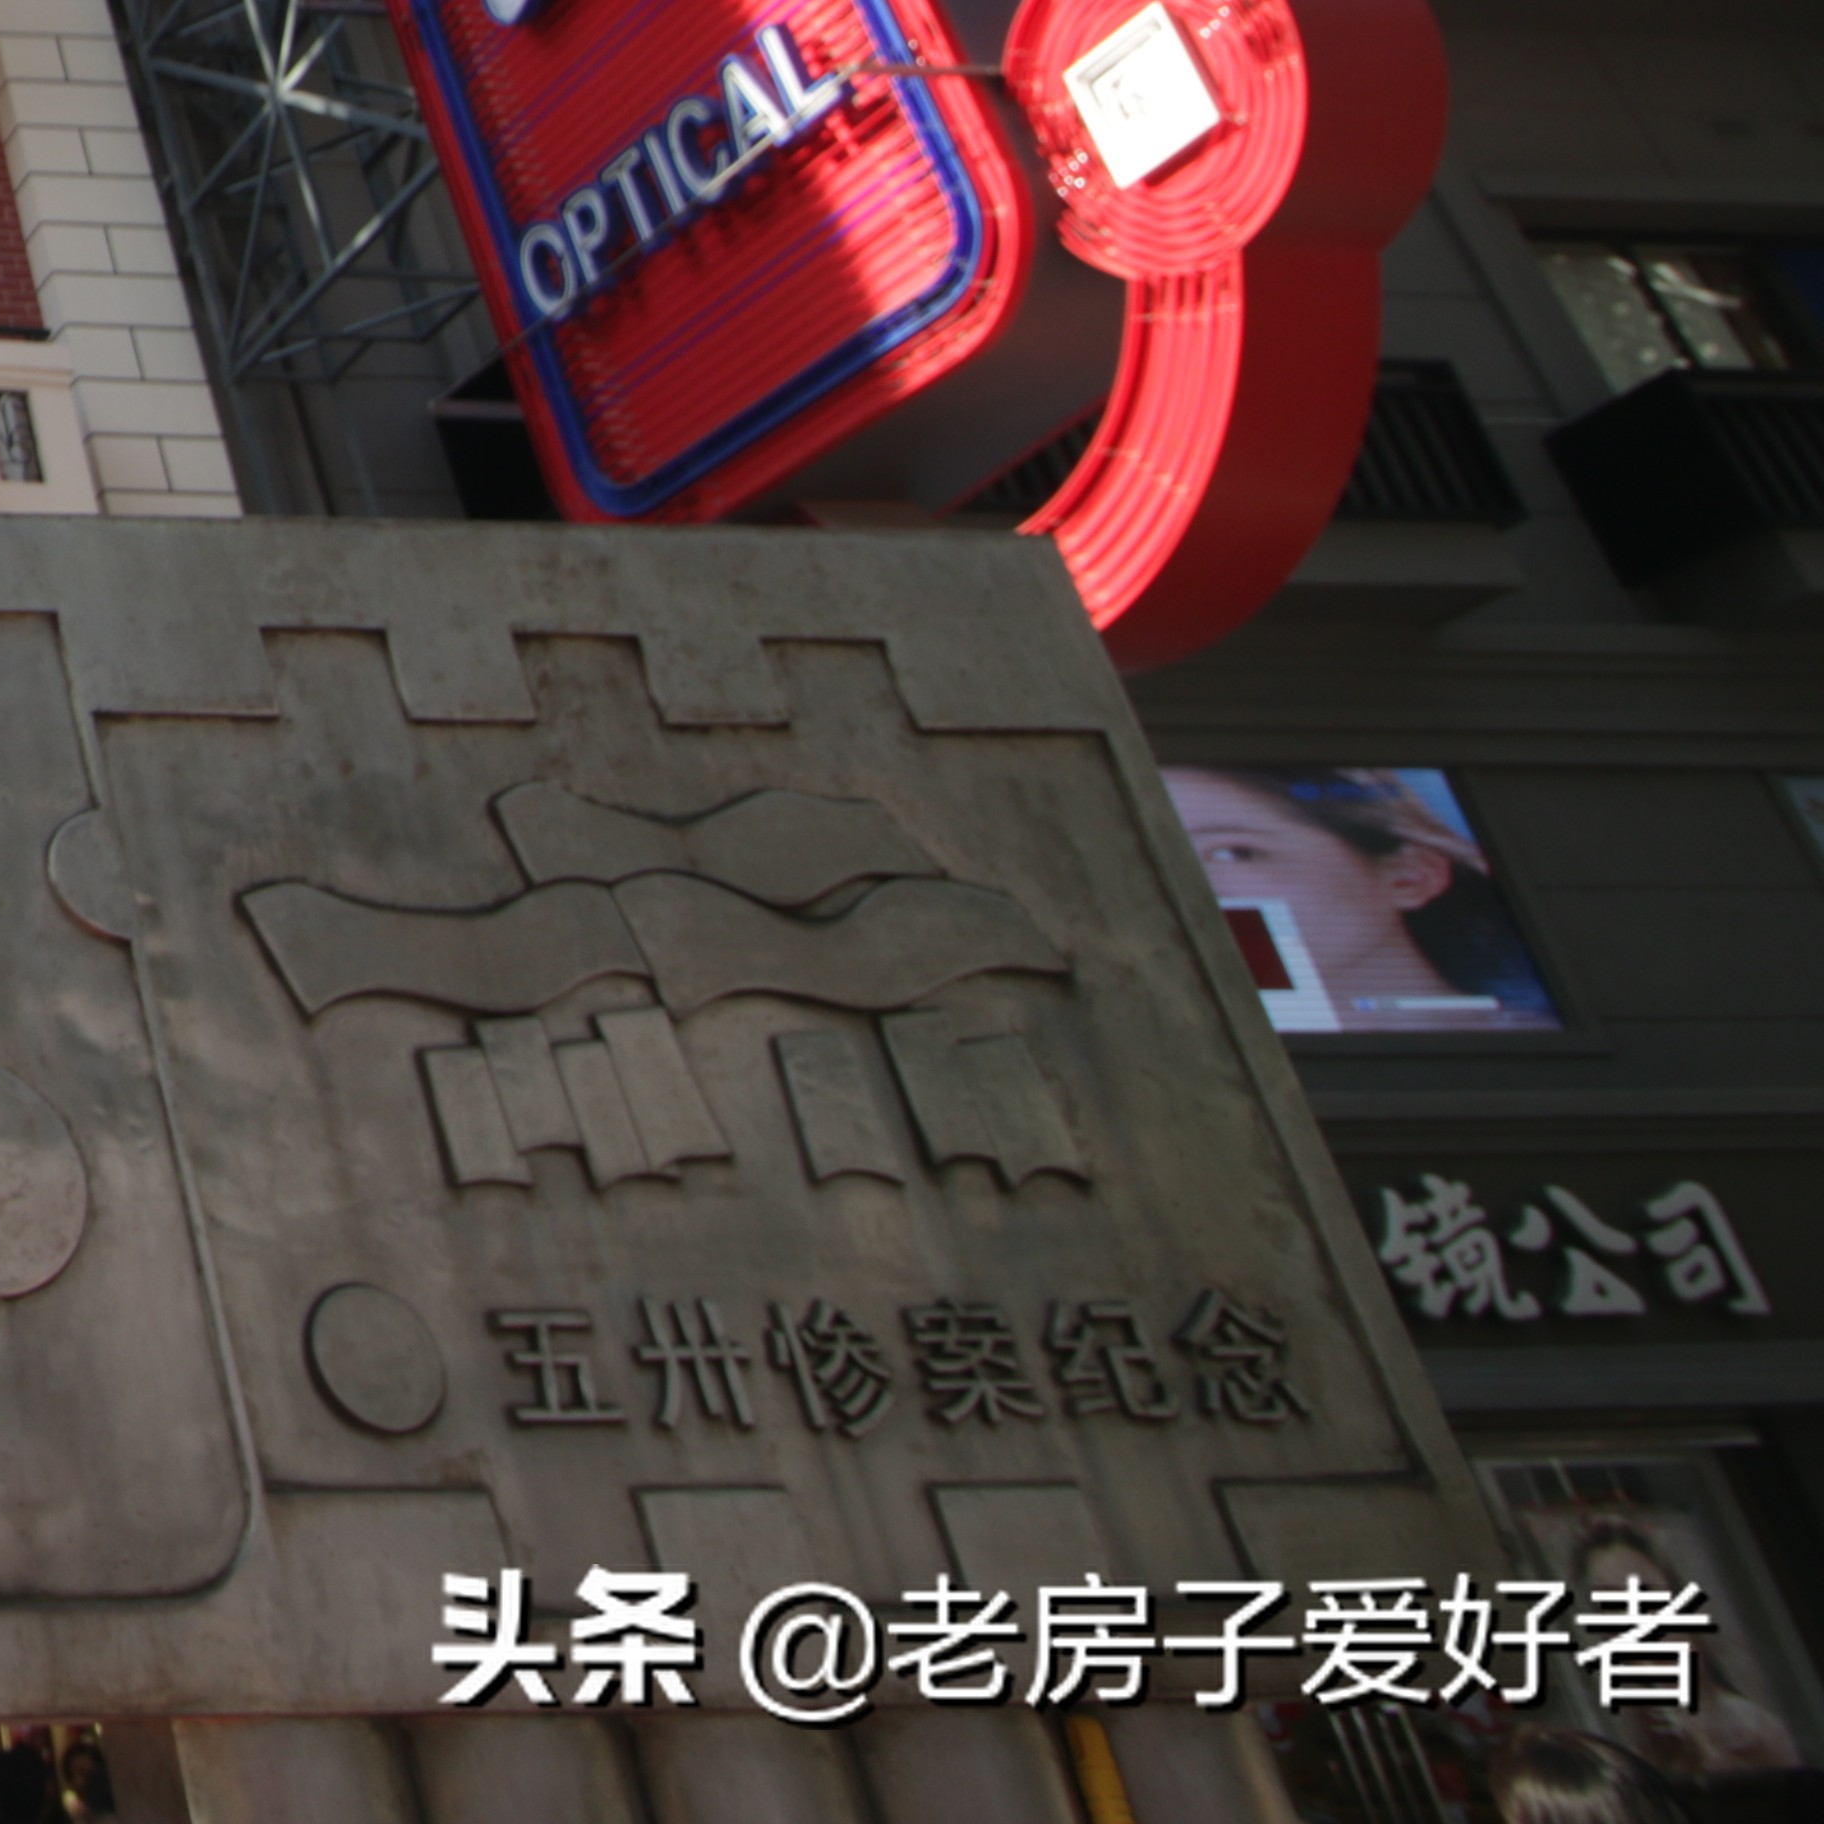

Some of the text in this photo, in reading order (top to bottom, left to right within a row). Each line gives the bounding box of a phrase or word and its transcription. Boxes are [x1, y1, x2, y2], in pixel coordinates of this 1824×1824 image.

[511, 24, 845, 322] OPTICAL
[489, 1285, 1310, 1438] 五卅惨案纪念
